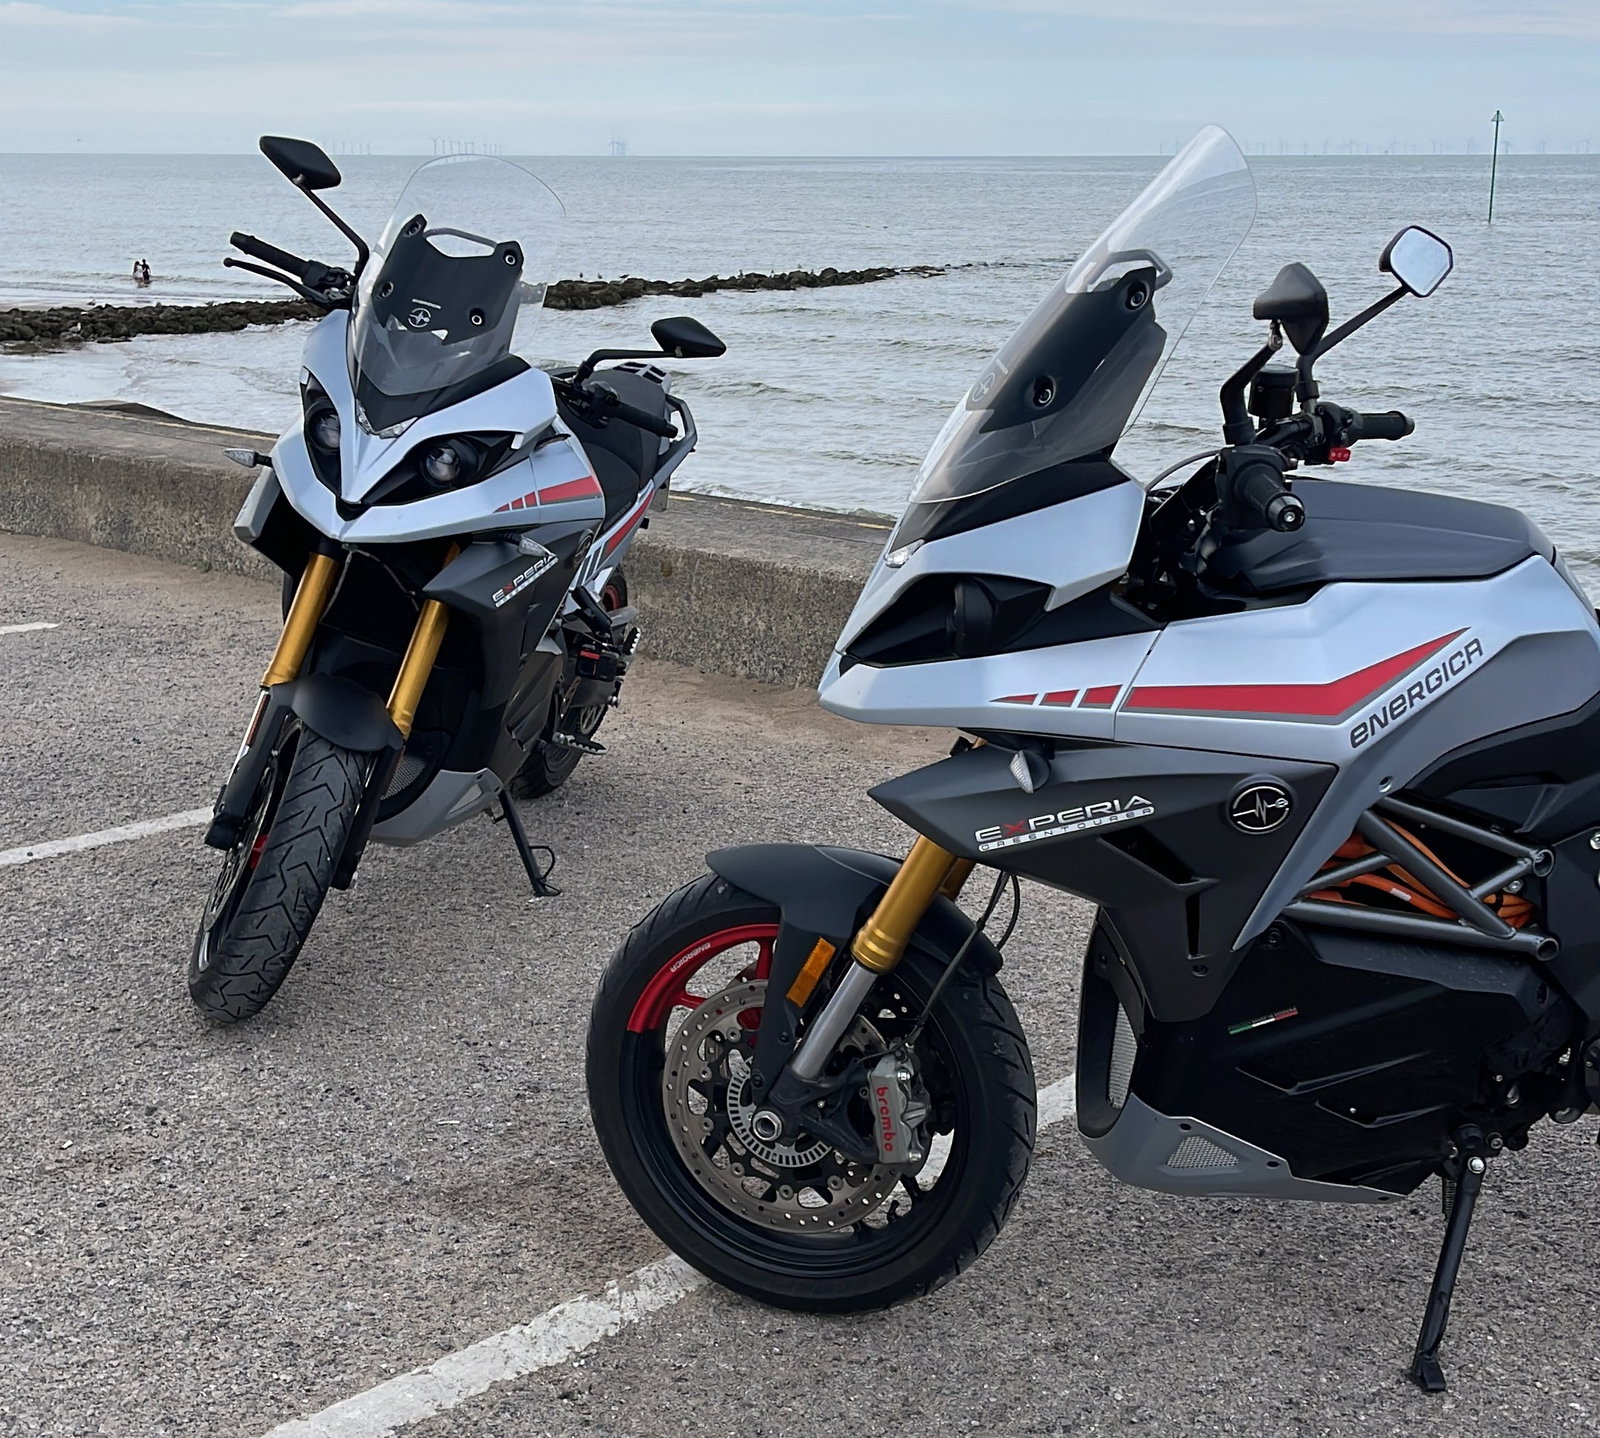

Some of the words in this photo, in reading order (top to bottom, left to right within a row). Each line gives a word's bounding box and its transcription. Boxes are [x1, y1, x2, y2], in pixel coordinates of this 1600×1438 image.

[492, 555, 557, 602] EXPERIA
[975, 795, 1153, 843] EXPERIA
[876, 1087, 896, 1152] brembo
